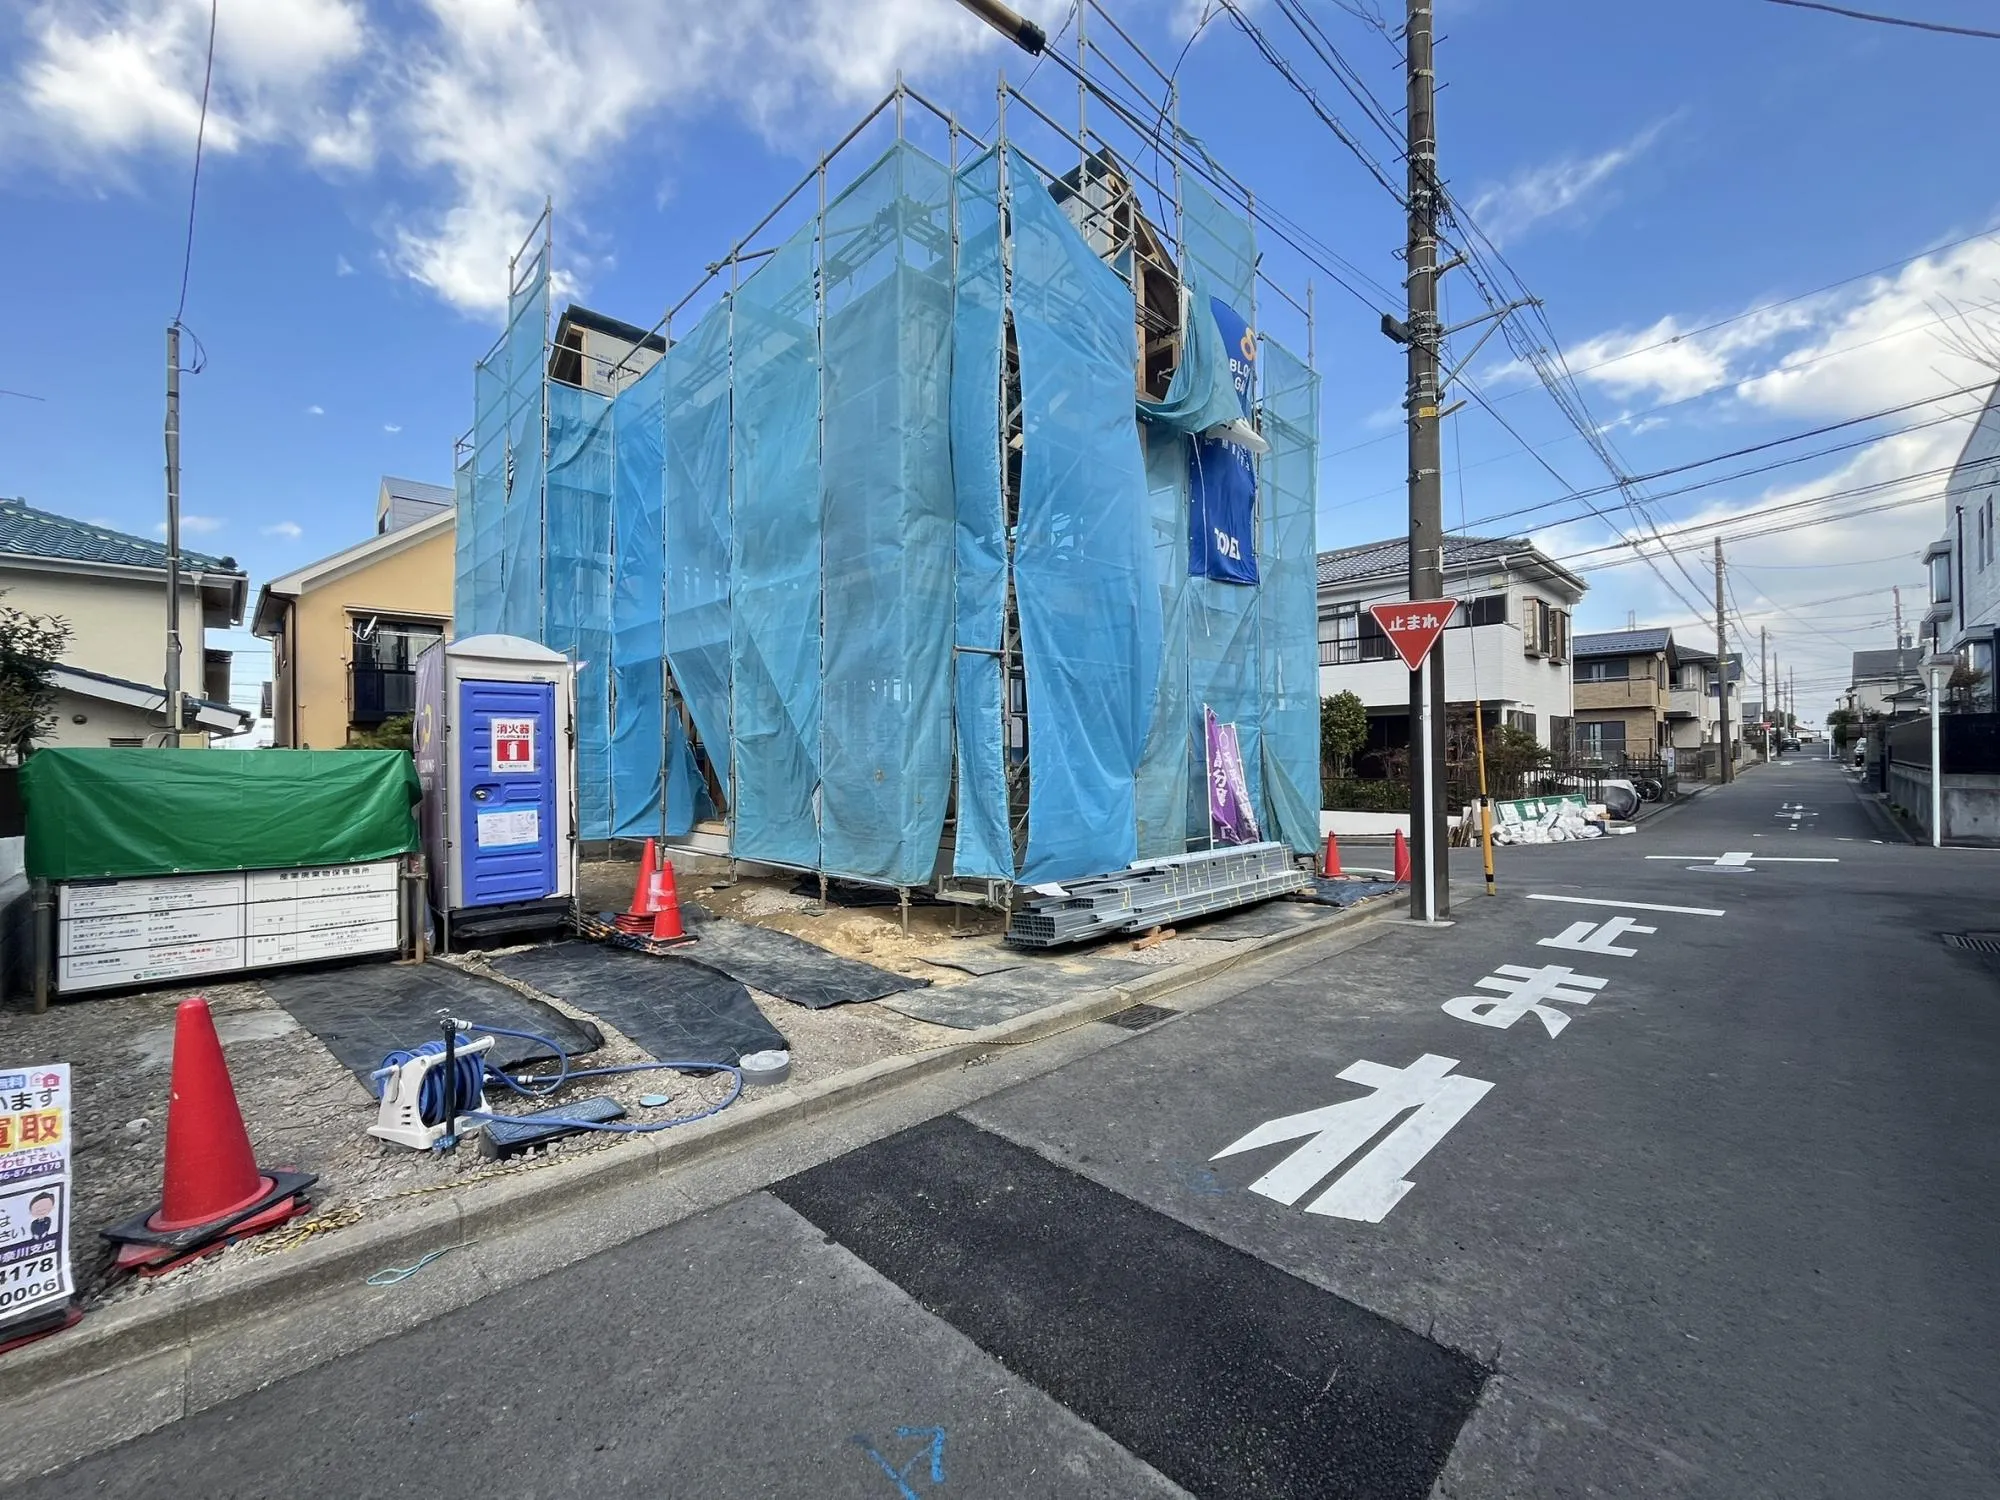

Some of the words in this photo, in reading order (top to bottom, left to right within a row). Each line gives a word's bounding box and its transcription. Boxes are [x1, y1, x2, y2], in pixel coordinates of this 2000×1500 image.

[1388, 613, 1440, 632] 止まれ
[497, 723, 530, 735] 消火器
[0, 1238, 57, 1264] 奈川支店
